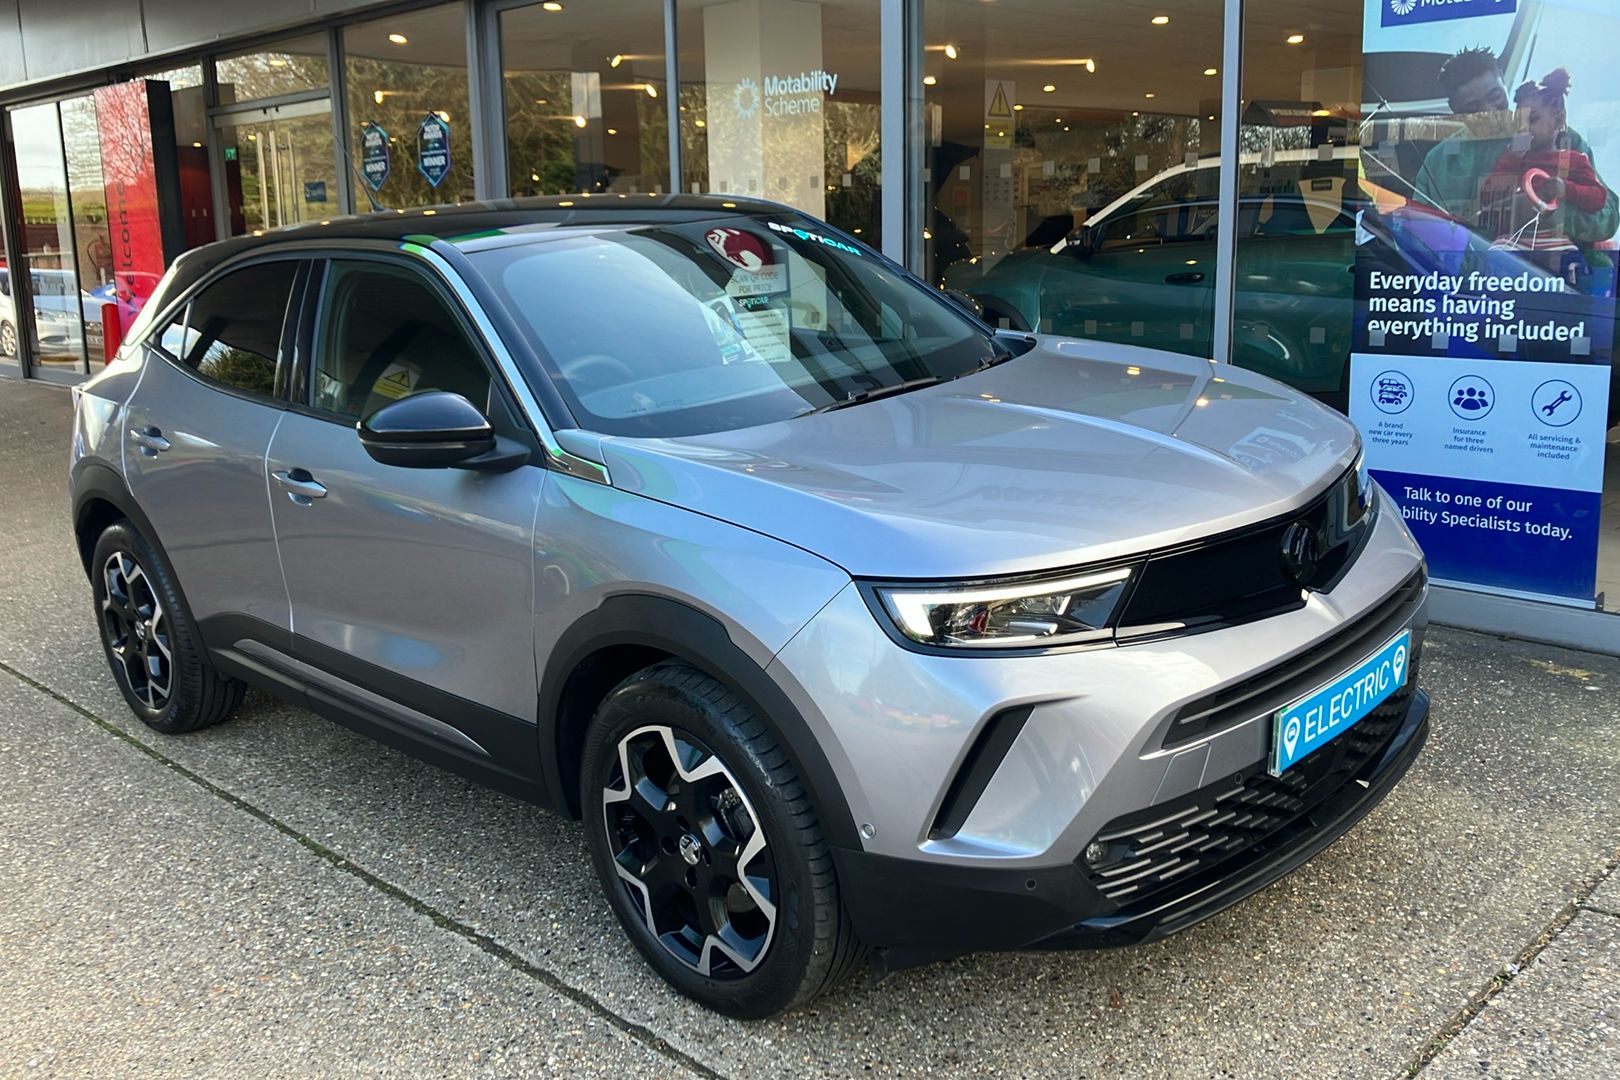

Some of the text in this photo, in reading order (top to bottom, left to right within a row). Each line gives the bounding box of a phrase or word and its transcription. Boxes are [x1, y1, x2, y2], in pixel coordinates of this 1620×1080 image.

[764, 70, 838, 95] Motability
[764, 97, 820, 117] Scheme
[1370, 271, 1565, 294] Everyday freedom
[1369, 295, 1516, 320] means having
[1368, 317, 1479, 342] everything
[1384, 421, 1404, 429] brand
[1395, 431, 1414, 439] every
[1452, 427, 1487, 436] Insurance
[1372, 436, 1409, 446] three years
[1454, 435, 1484, 444] for three
[1539, 434, 1573, 445] servicing
[1444, 443, 1494, 453] named drivers
[1530, 442, 1578, 452] maintenance
[1537, 451, 1570, 460] included
[1404, 486, 1533, 513] Talk to one of our
[1400, 505, 1573, 542] bility Specialists today.
[1304, 660, 1390, 743] ELECTRIC
